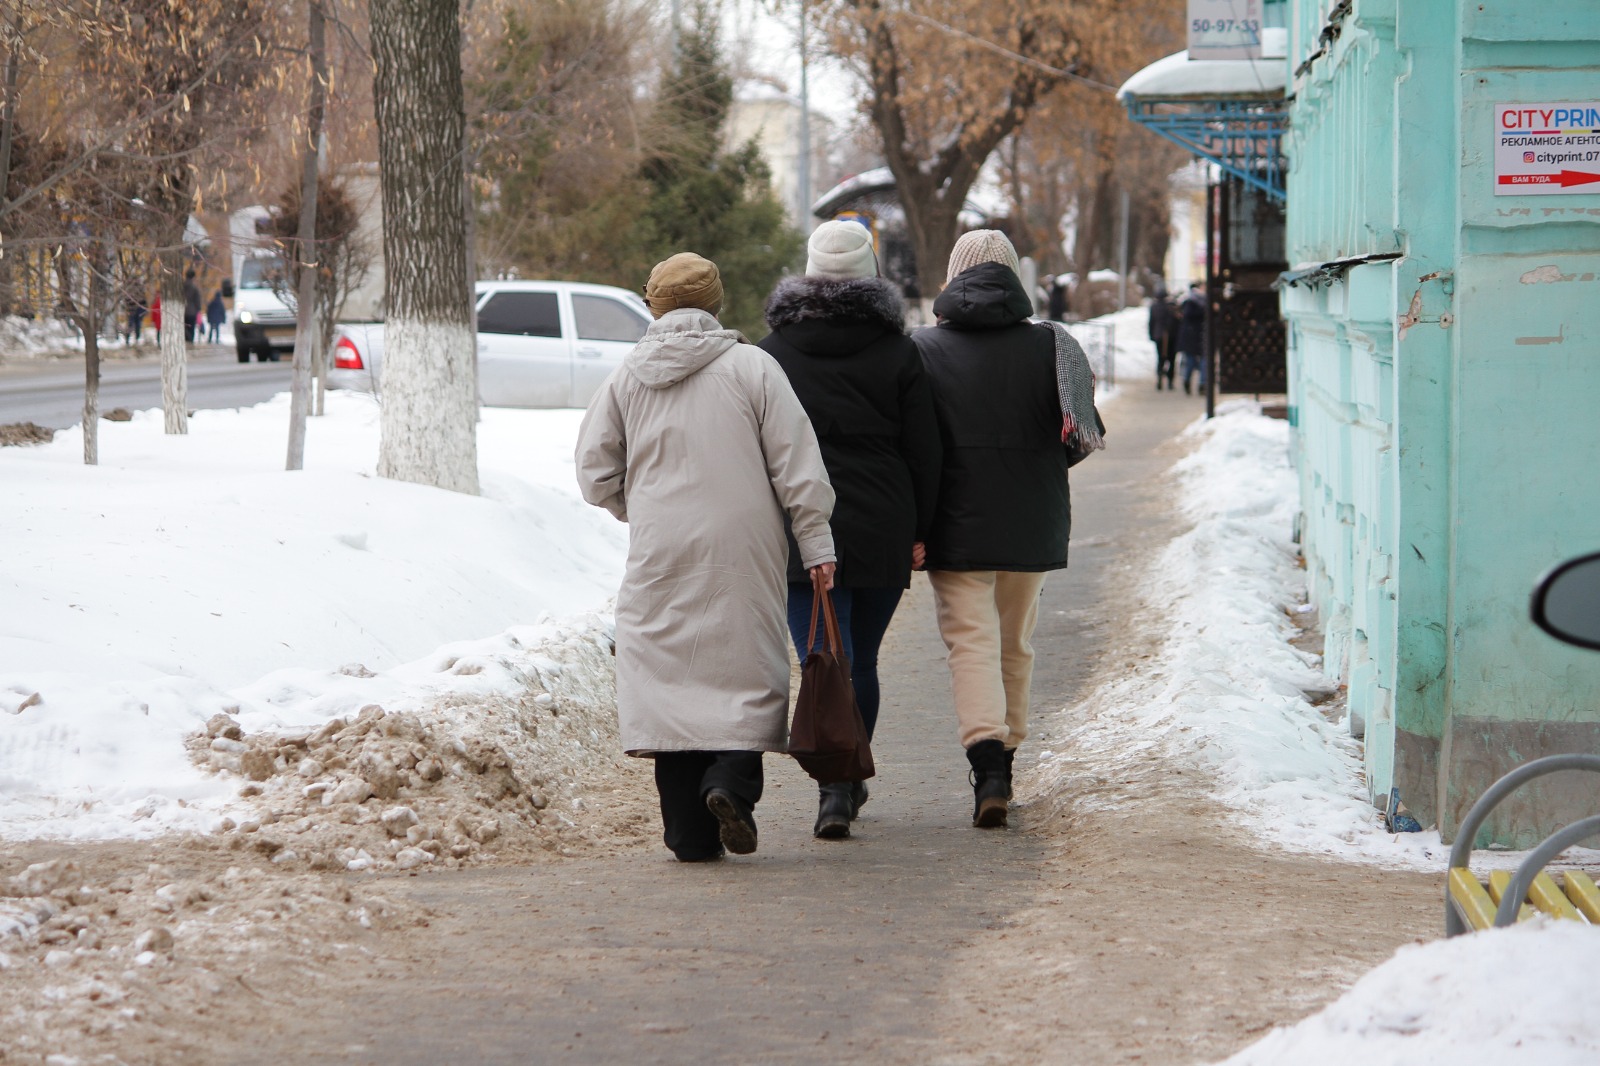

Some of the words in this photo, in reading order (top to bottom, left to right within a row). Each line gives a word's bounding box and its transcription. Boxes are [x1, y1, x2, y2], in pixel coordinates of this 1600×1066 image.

[1192, 19, 1259, 32] 50-97-33
[1502, 137, 1562, 146] РЕКЛАМНОЕ
[1537, 151, 1600, 164] cityprint.07
